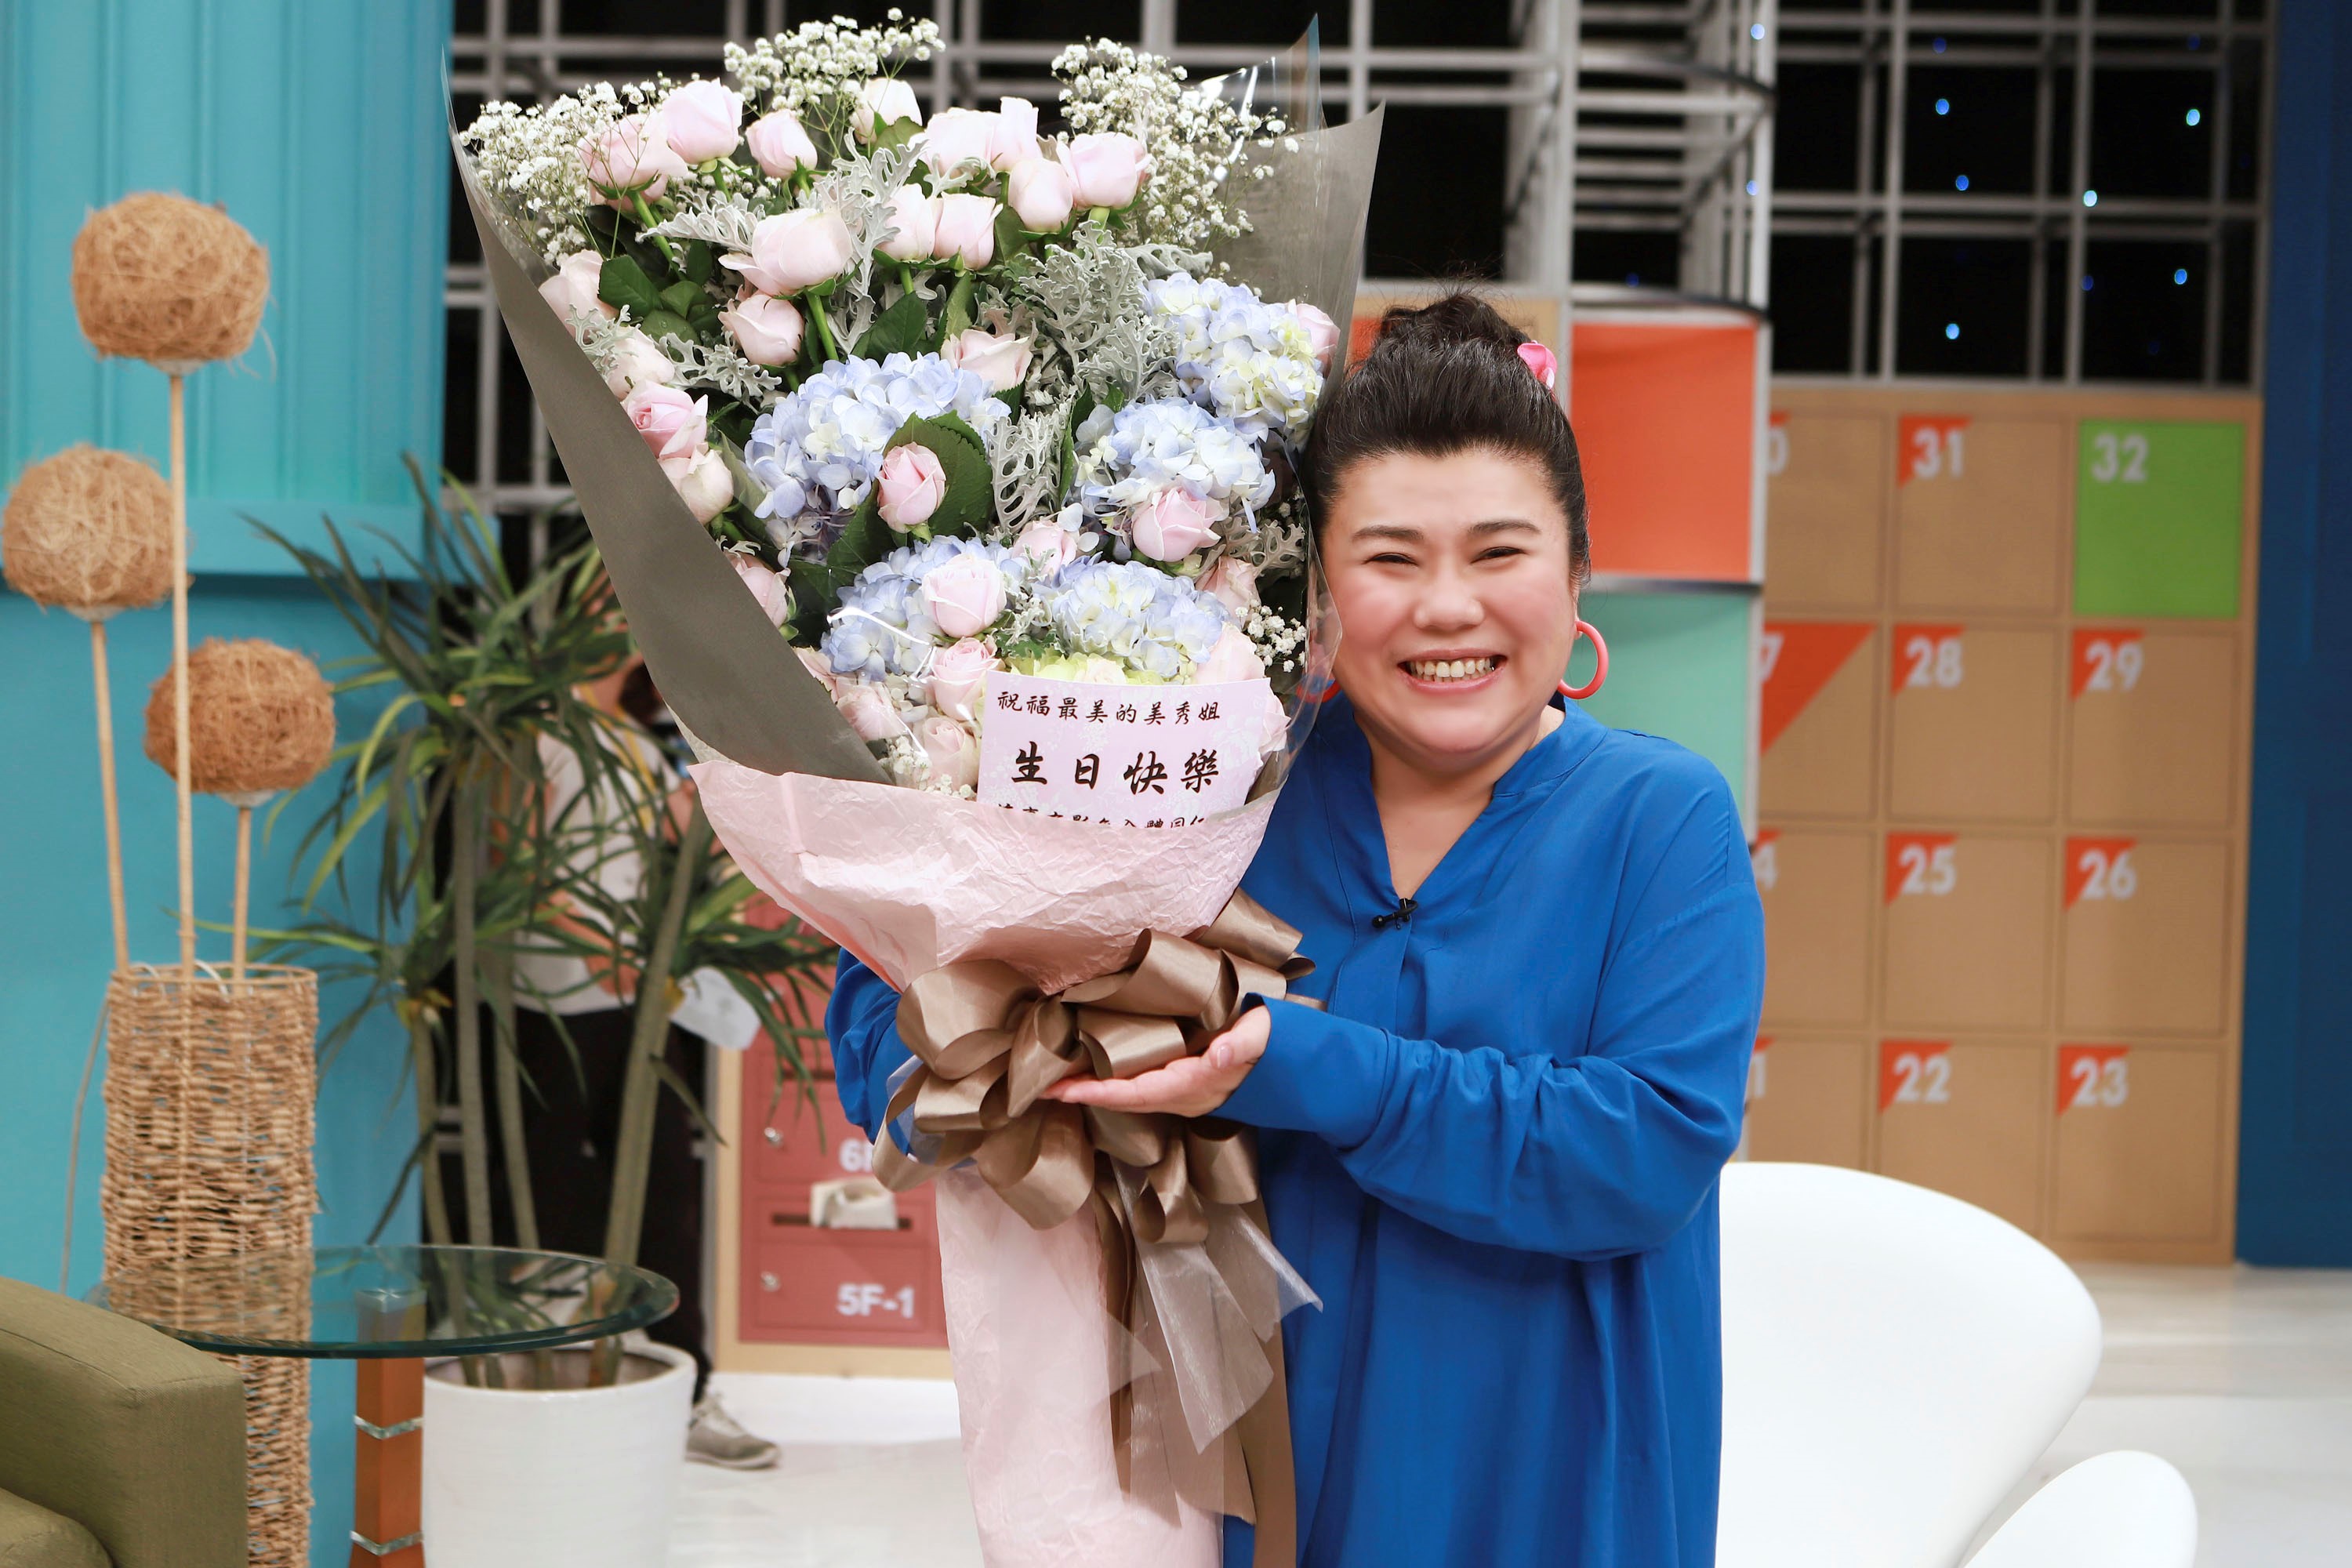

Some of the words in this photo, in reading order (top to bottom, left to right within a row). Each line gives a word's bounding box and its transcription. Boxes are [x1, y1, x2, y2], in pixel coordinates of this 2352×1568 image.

[1914, 429, 1965, 481] 31
[2090, 432, 2150, 484] 32
[1907, 637, 1965, 690] 28
[2086, 641, 2145, 691] 29
[997, 691, 1221, 725] 祝福最美的美秀姐
[1011, 740, 1220, 796] 生日快樂
[1899, 845, 1958, 896] 25
[2080, 851, 2138, 901] 26
[1893, 1054, 1952, 1105] 22
[2071, 1058, 2130, 1109] 23
[836, 1282, 916, 1319] 5F-1
